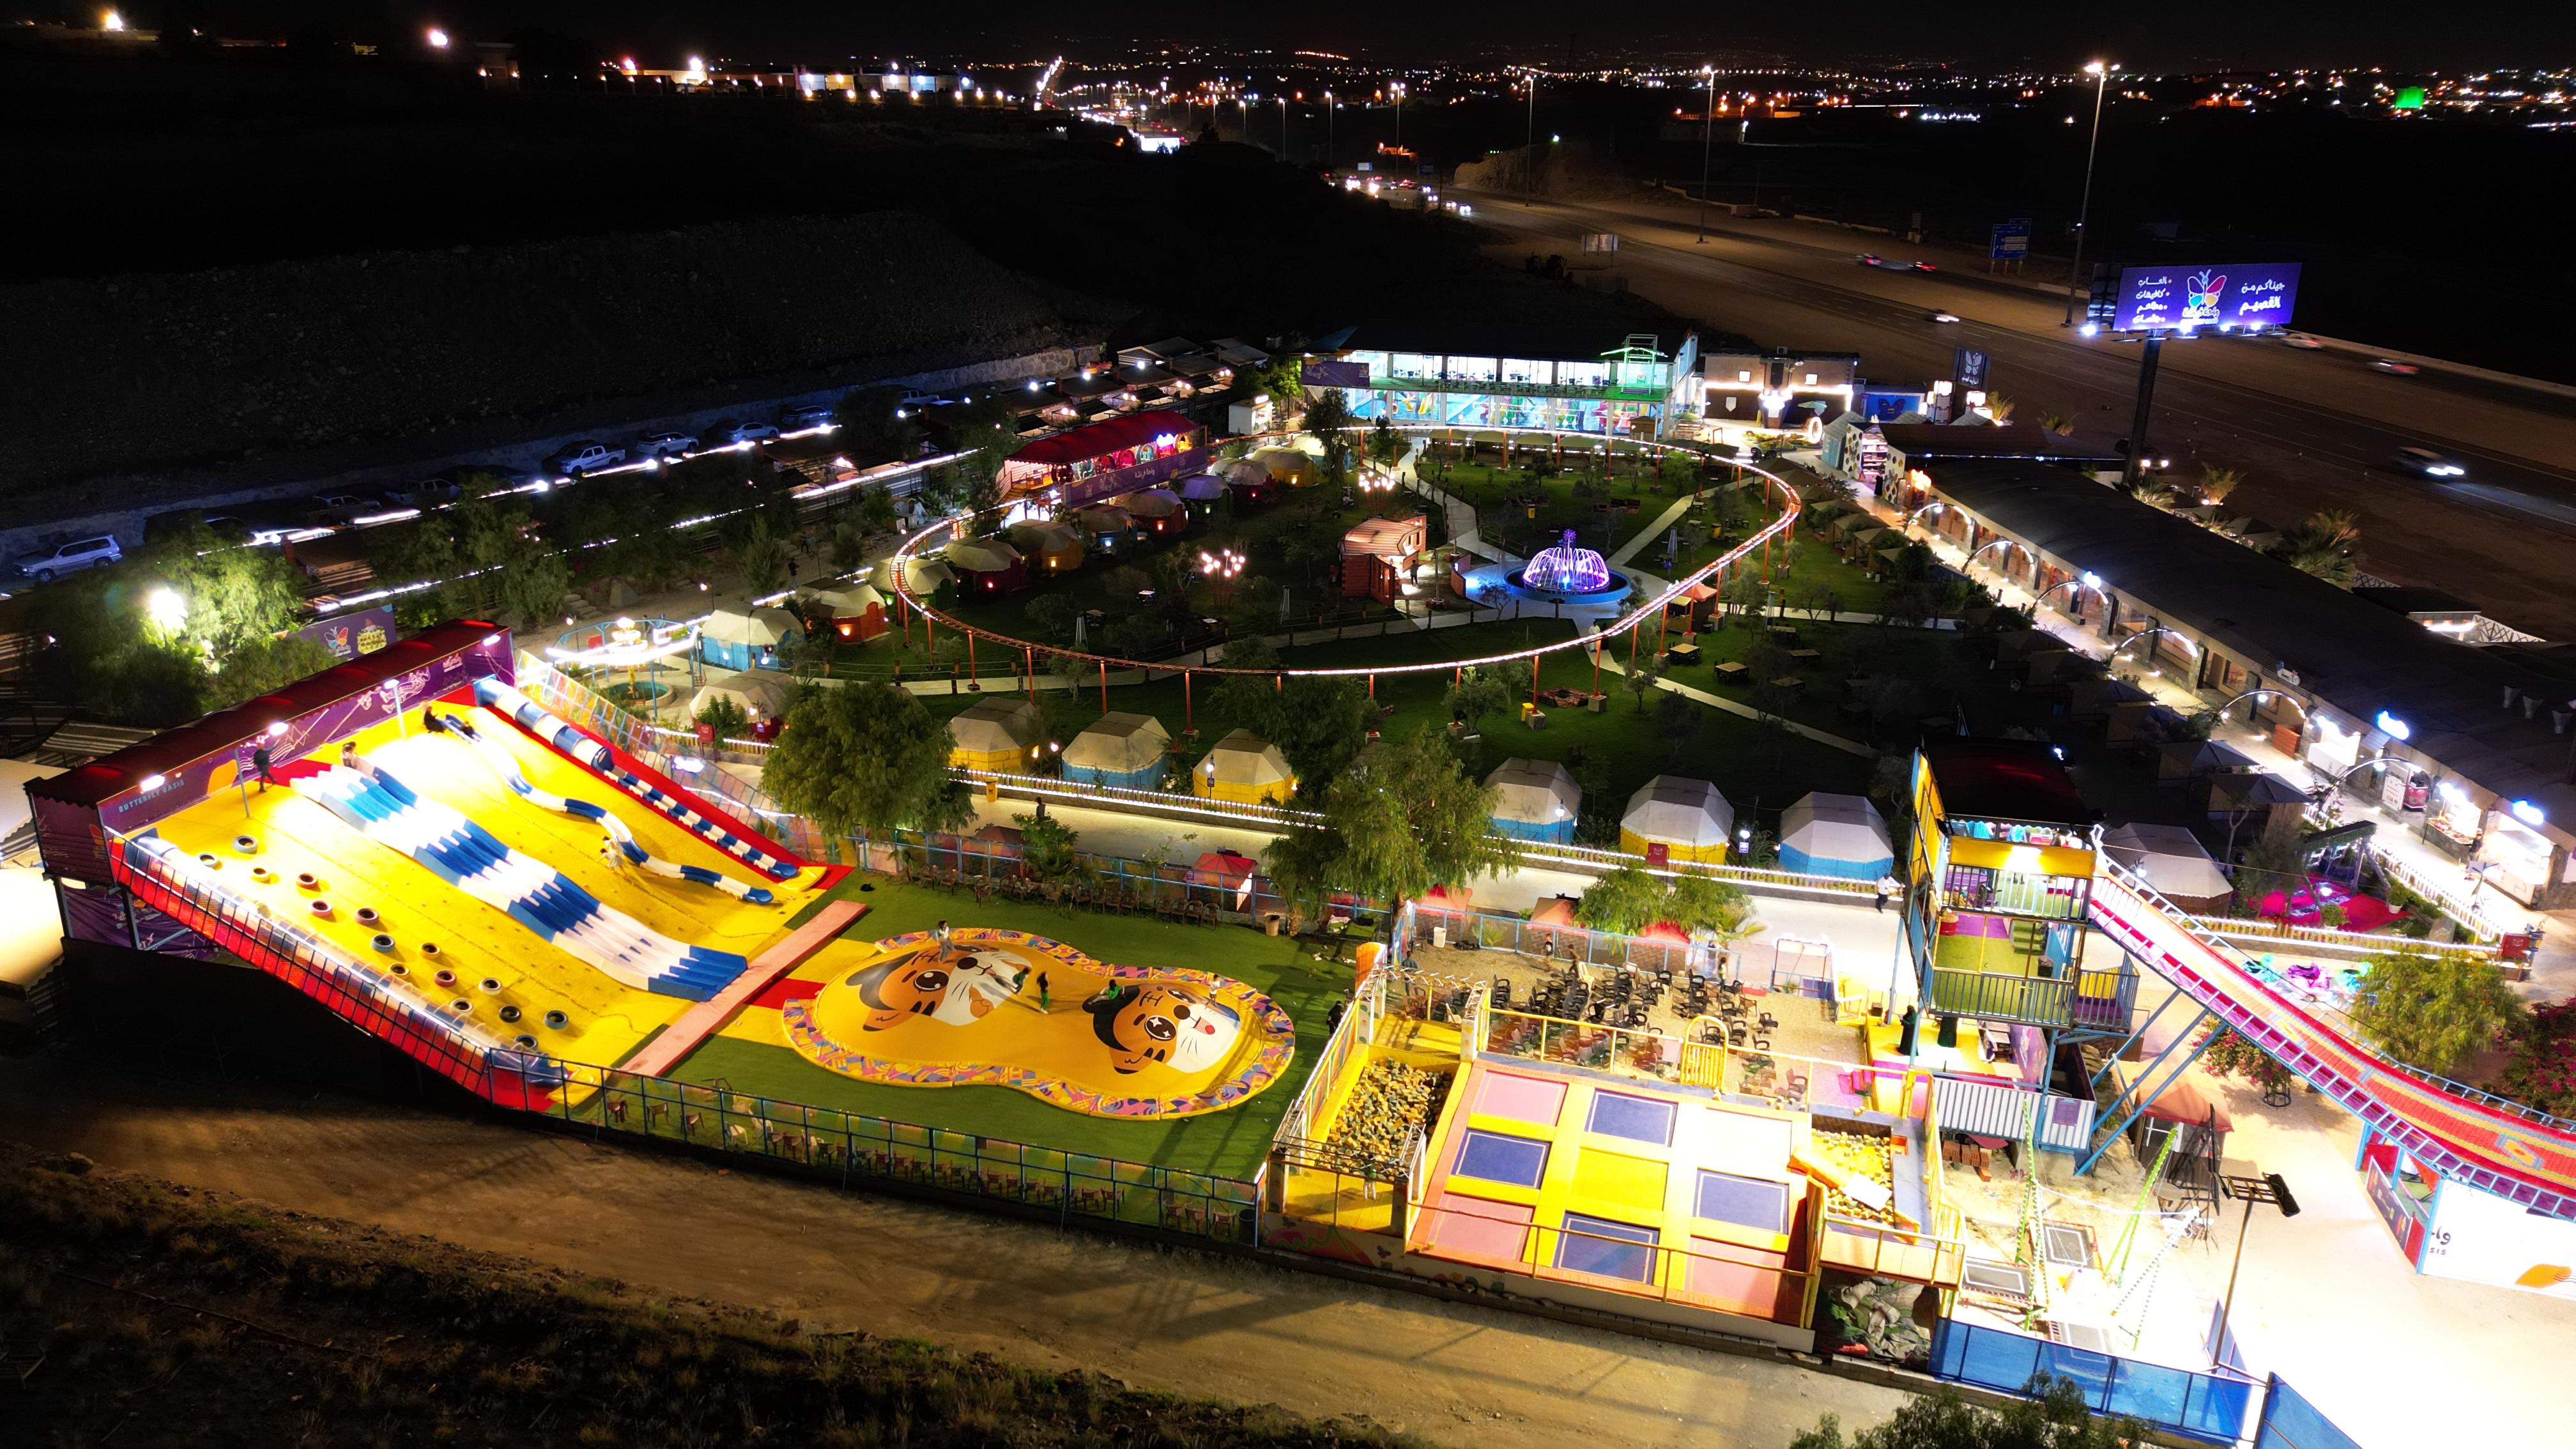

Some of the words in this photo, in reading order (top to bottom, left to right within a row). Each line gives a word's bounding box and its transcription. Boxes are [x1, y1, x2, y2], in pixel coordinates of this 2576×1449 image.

[2239, 296, 2281, 316] القصيم
[118, 791, 160, 813] BUTTERFLY
[163, 779, 185, 793] OASIS
[2430, 1247, 2447, 1255] SIS
